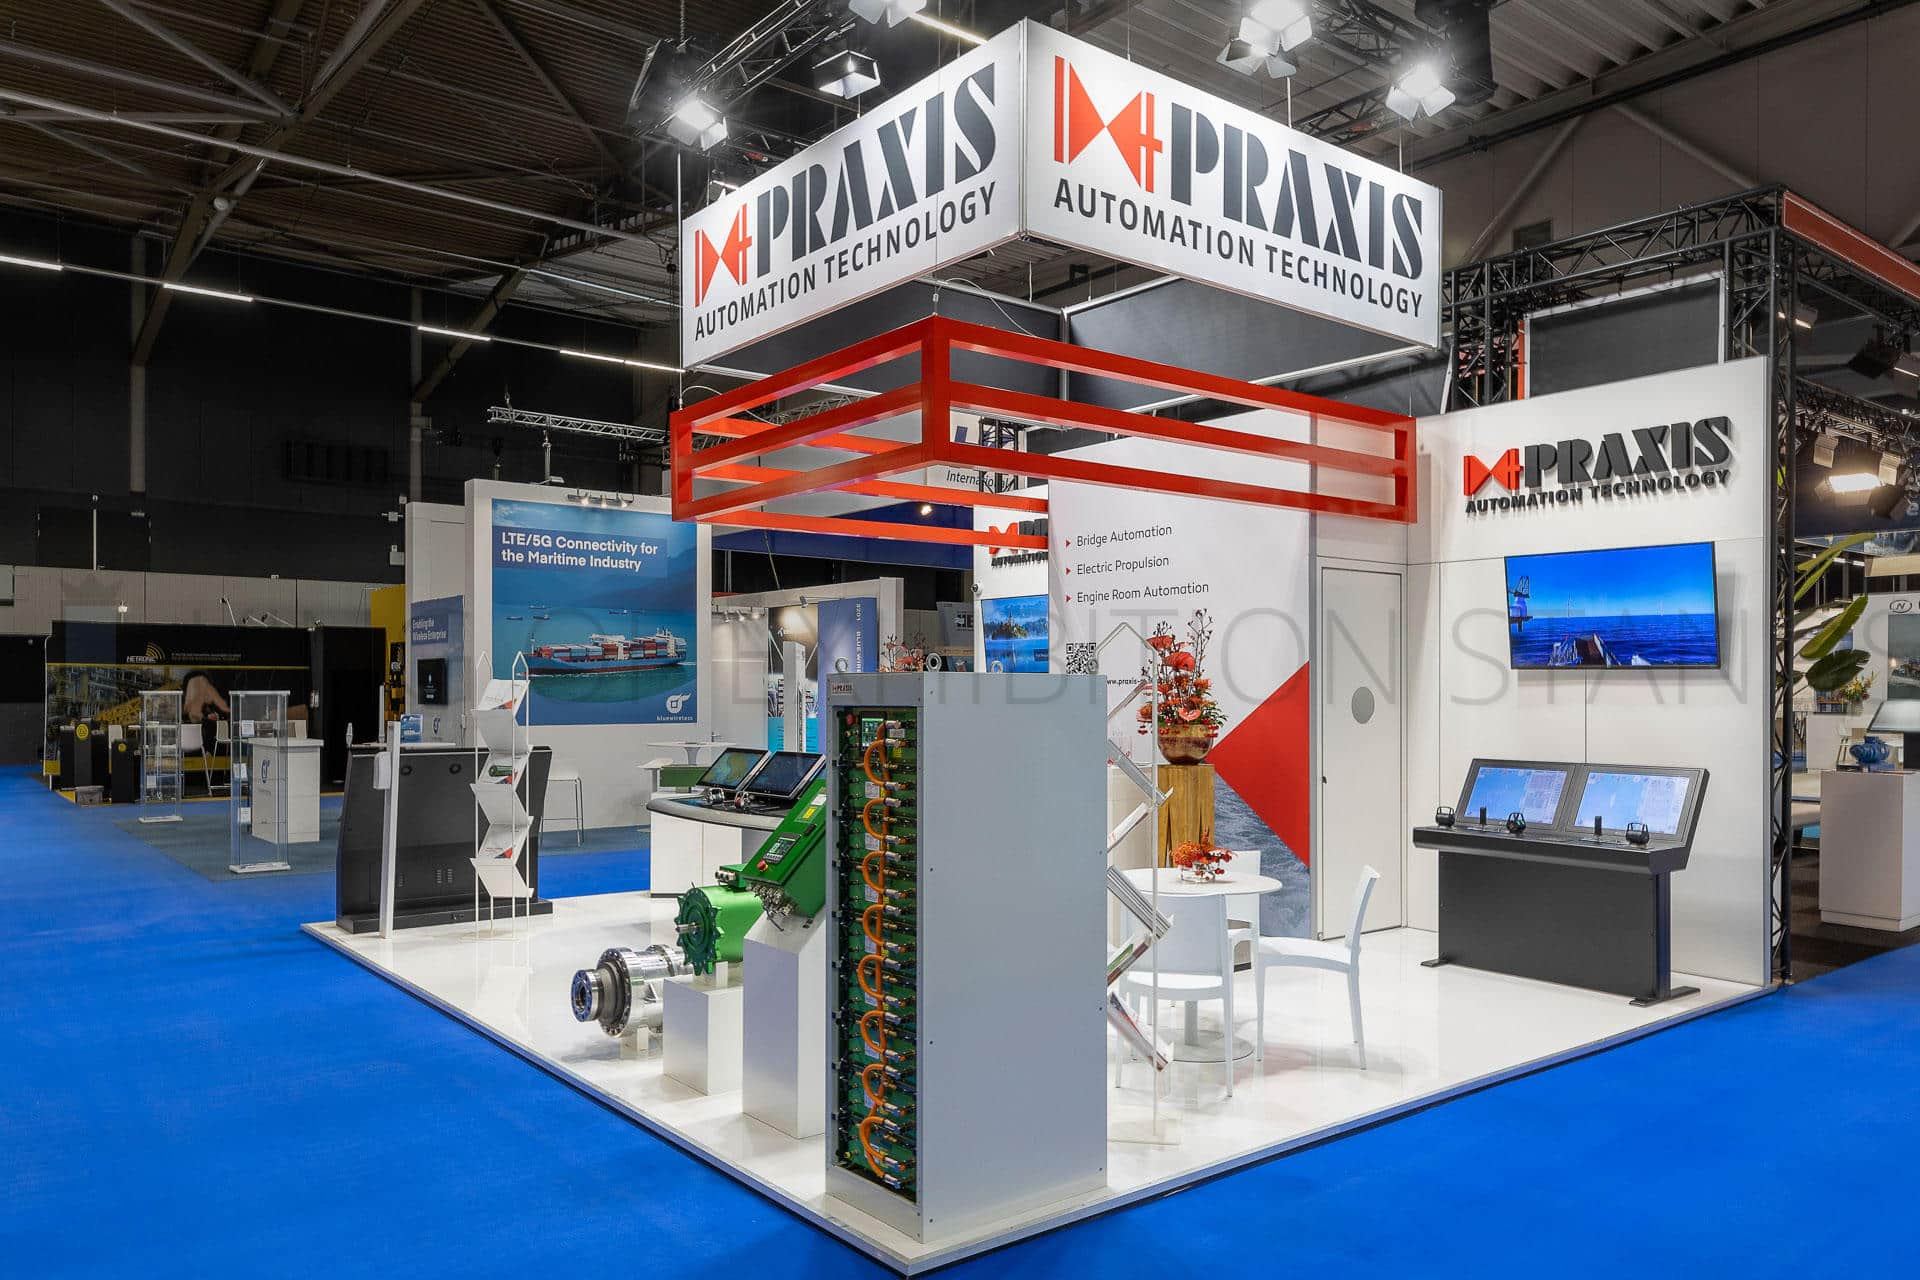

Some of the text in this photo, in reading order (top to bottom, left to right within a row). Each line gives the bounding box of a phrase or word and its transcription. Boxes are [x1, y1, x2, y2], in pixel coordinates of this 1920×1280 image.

[756, 63, 996, 278] PRAXIS
[1171, 102, 1423, 280] PRAXIS
[695, 181, 996, 341] AUTOMATION TECHNOLOGY
[1054, 178, 1423, 318] AUTOMATION TECHNOLOGY
[1524, 416, 1732, 488] PRAXIS
[946, 469, 1009, 489] Internaioal
[1465, 468, 1730, 515] AUTOMATION TECHNOLOGY
[501, 531, 658, 556] LTE/5G Connectivity for
[1076, 524, 1173, 549] Bridge Automation
[501, 549, 642, 571] the Maritime Industry
[1076, 555, 1170, 575] Electric Propulsion
[1076, 581, 1210, 606] Engine Room Automation
